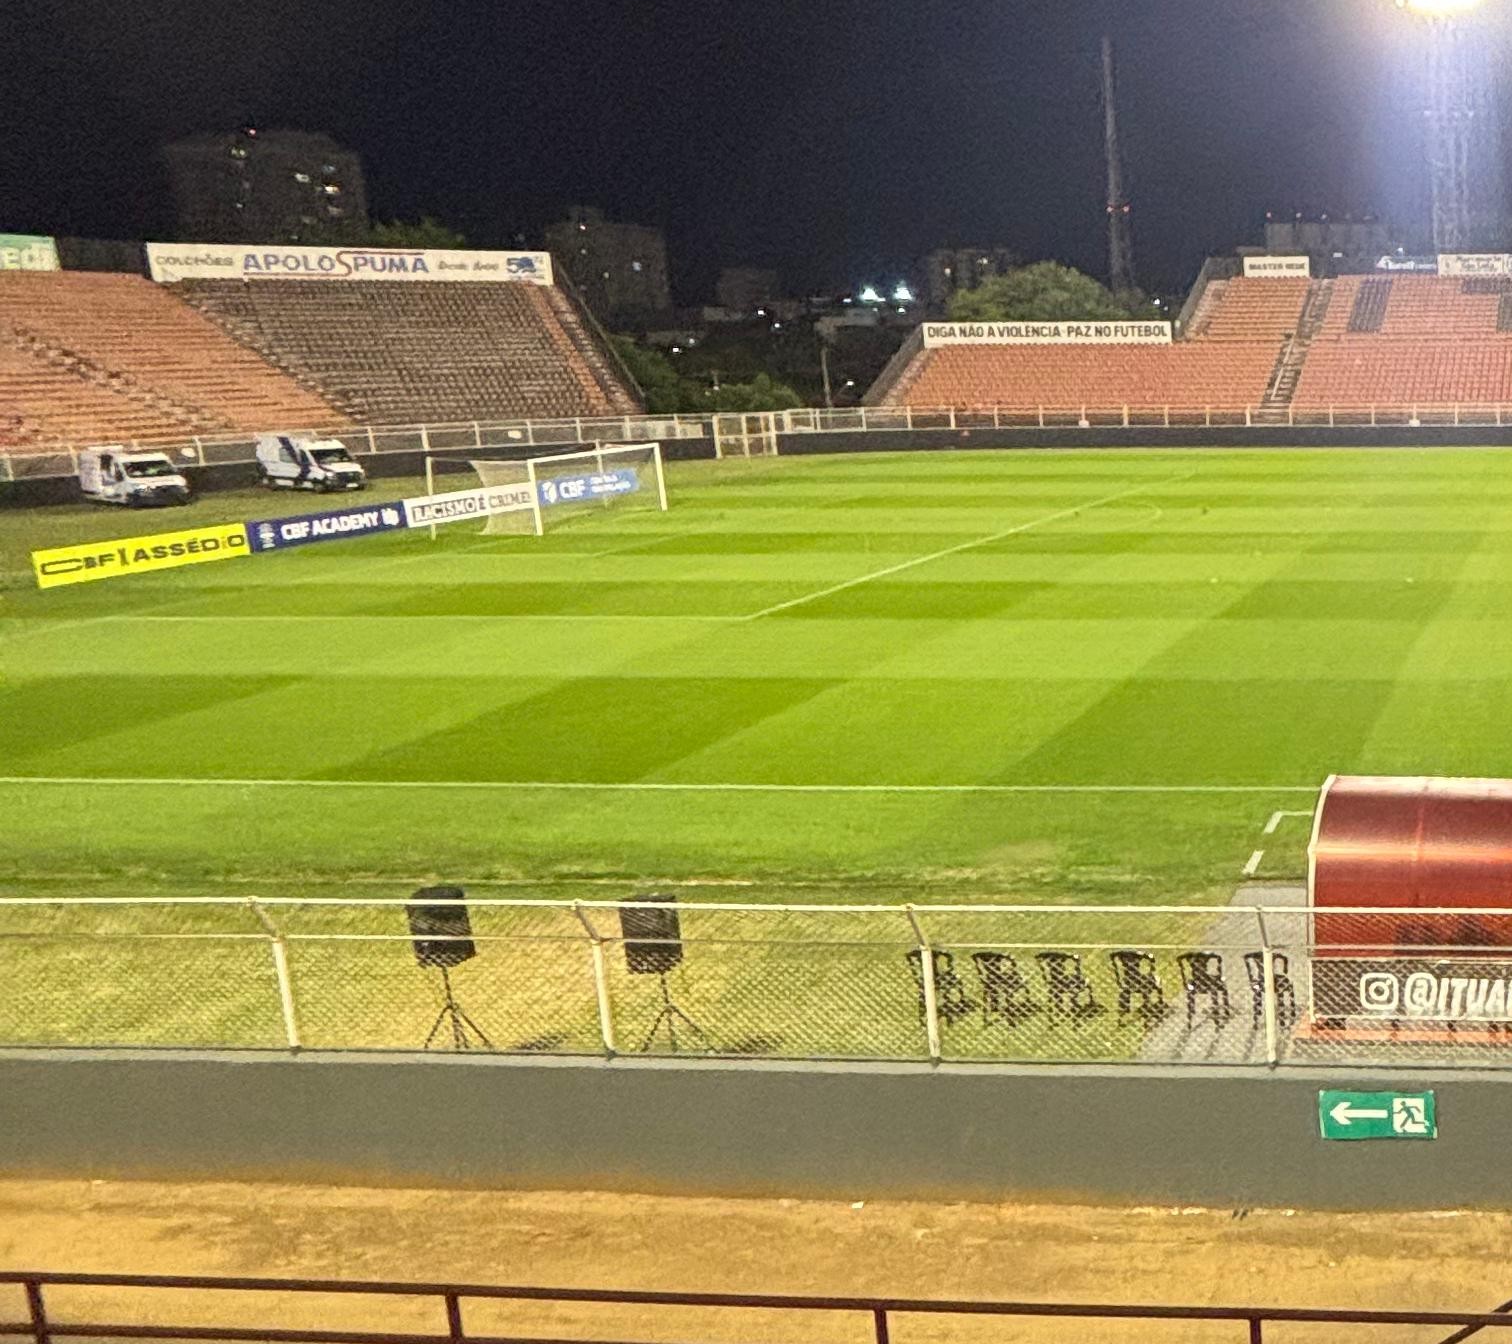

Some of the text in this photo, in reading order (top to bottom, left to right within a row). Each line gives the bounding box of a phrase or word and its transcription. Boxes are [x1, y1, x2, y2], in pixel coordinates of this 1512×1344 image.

[928, 325, 956, 339] DIGA
[1067, 324, 1092, 337] PAZ
[1095, 325, 1112, 337] NO
[1114, 324, 1167, 337] FUTEBOL
[559, 479, 587, 498] CBF
[411, 499, 477, 523] RACISMO
[280, 511, 379, 540] CBF ACADEMY
